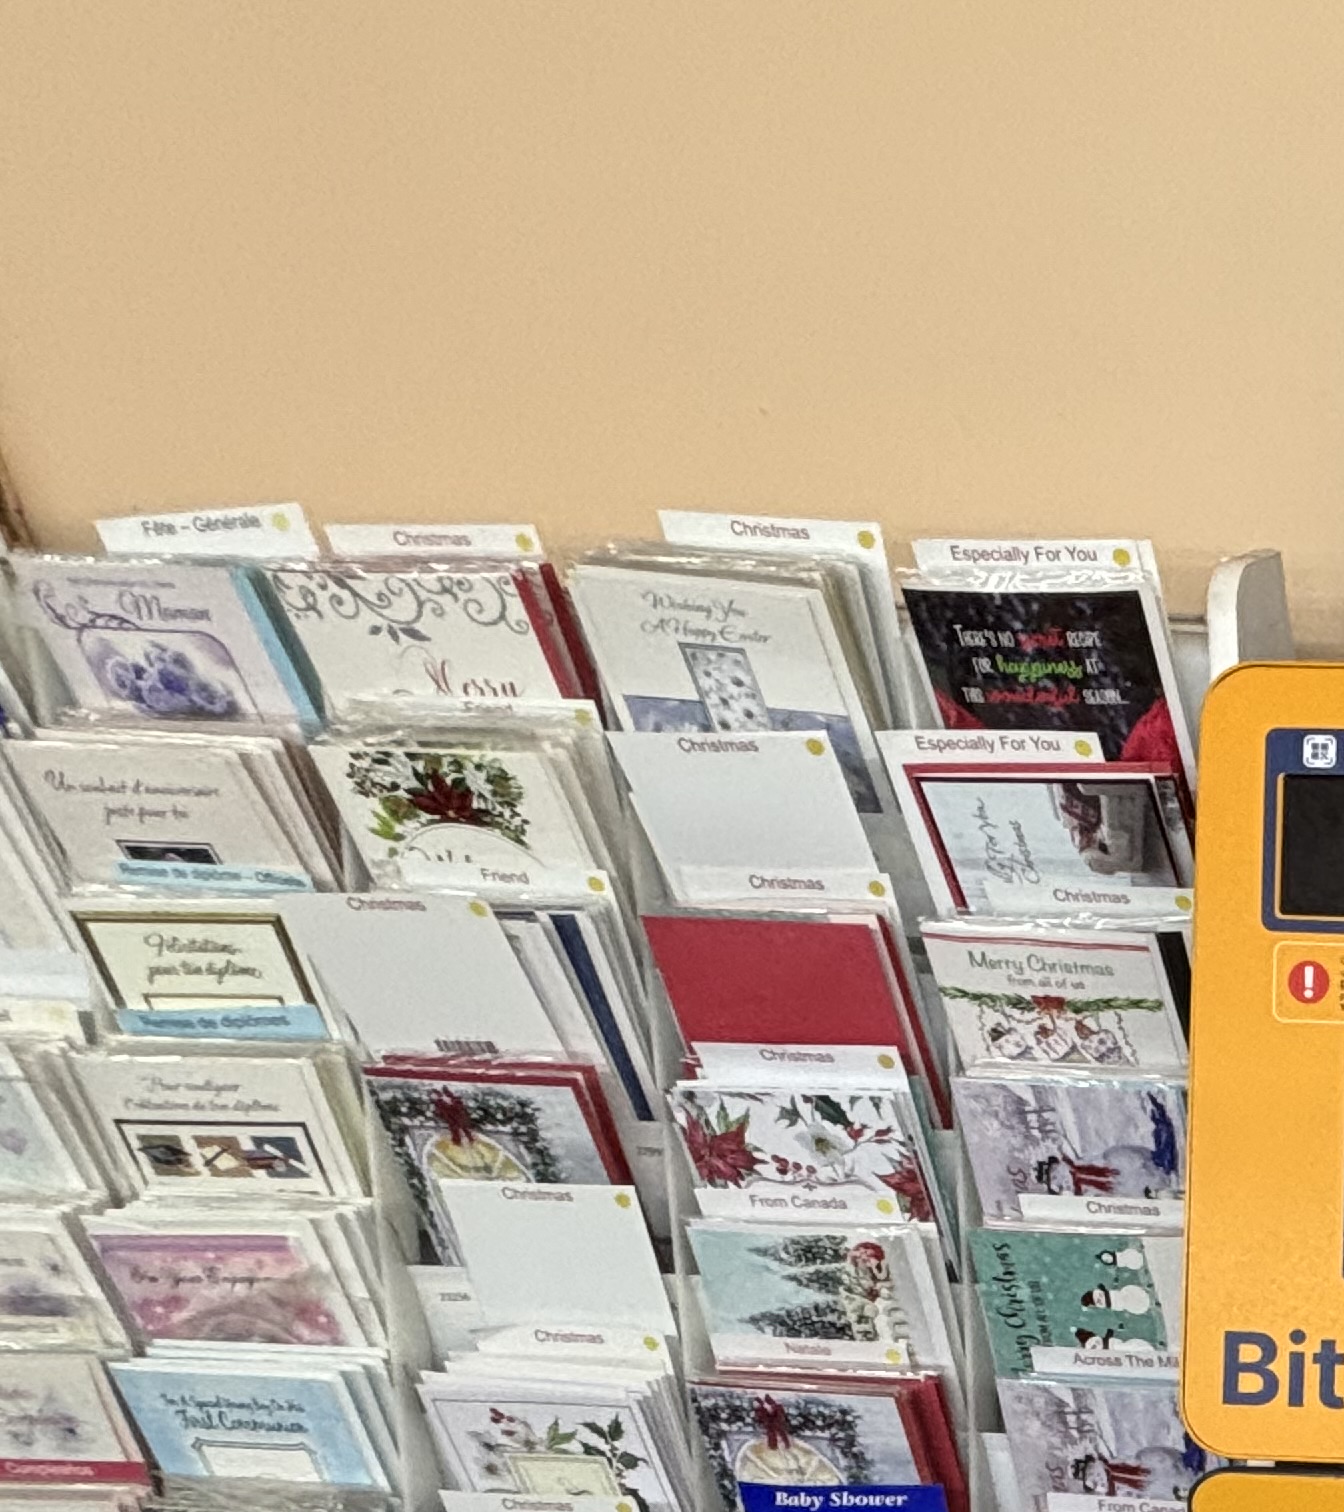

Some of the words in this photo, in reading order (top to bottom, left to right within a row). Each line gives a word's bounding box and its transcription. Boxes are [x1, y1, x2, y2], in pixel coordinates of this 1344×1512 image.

[393, 531, 472, 547] Christmas
[731, 521, 810, 541] Christmas
[950, 545, 1030, 565] Especially
[1033, 546, 1061, 562] For
[1063, 547, 1098, 563] You
[678, 737, 759, 753] Christmas
[916, 736, 994, 754] Especially
[999, 737, 1026, 753] For
[1029, 737, 1061, 753] You
[481, 868, 530, 884] Friend
[749, 875, 825, 891] Christmas
[347, 896, 426, 913] Christmas
[1053, 888, 1131, 905] Christmas
[968, 950, 1024, 975] Merry
[1026, 953, 1115, 976] Christmas
[759, 1049, 834, 1065] Christmas
[501, 1187, 573, 1203] Christmas
[750, 1194, 787, 1210] From
[791, 1195, 848, 1211] Canada
[1086, 1202, 1160, 1218] Christmas
[535, 1329, 604, 1345] Christmas
[1074, 1353, 1122, 1367] Across
[1125, 1355, 1153, 1367] The
[502, 1499, 573, 1512] Christmas
[775, 1491, 823, 1510] Baby
[829, 1491, 908, 1508] Shower
[1098, 1500, 1135, 1512] From
